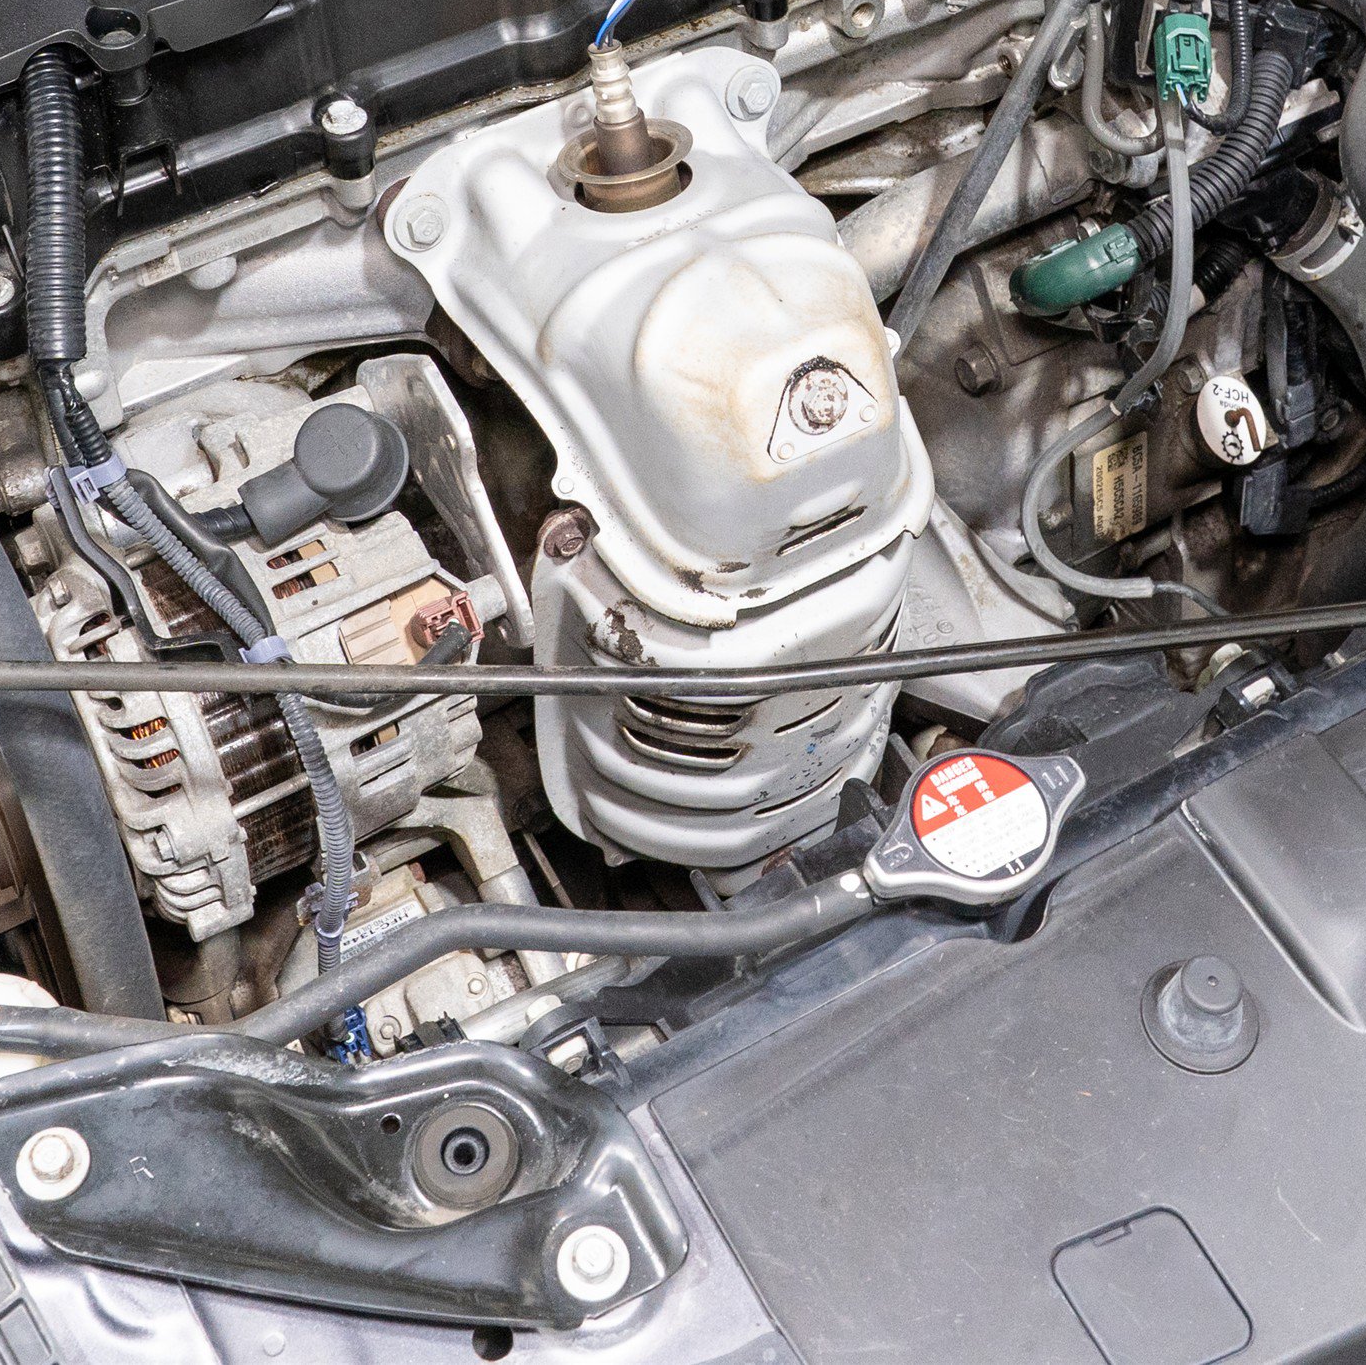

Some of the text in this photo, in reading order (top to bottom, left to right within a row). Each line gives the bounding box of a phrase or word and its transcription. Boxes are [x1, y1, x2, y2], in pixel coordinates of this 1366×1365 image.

[1212, 383, 1250, 404] HCF-2
[929, 756, 976, 787] DANGER
[1041, 764, 1070, 790] 1.1
[1005, 856, 1026, 875] 1.1
[342, 913, 410, 947] HFC-134a
